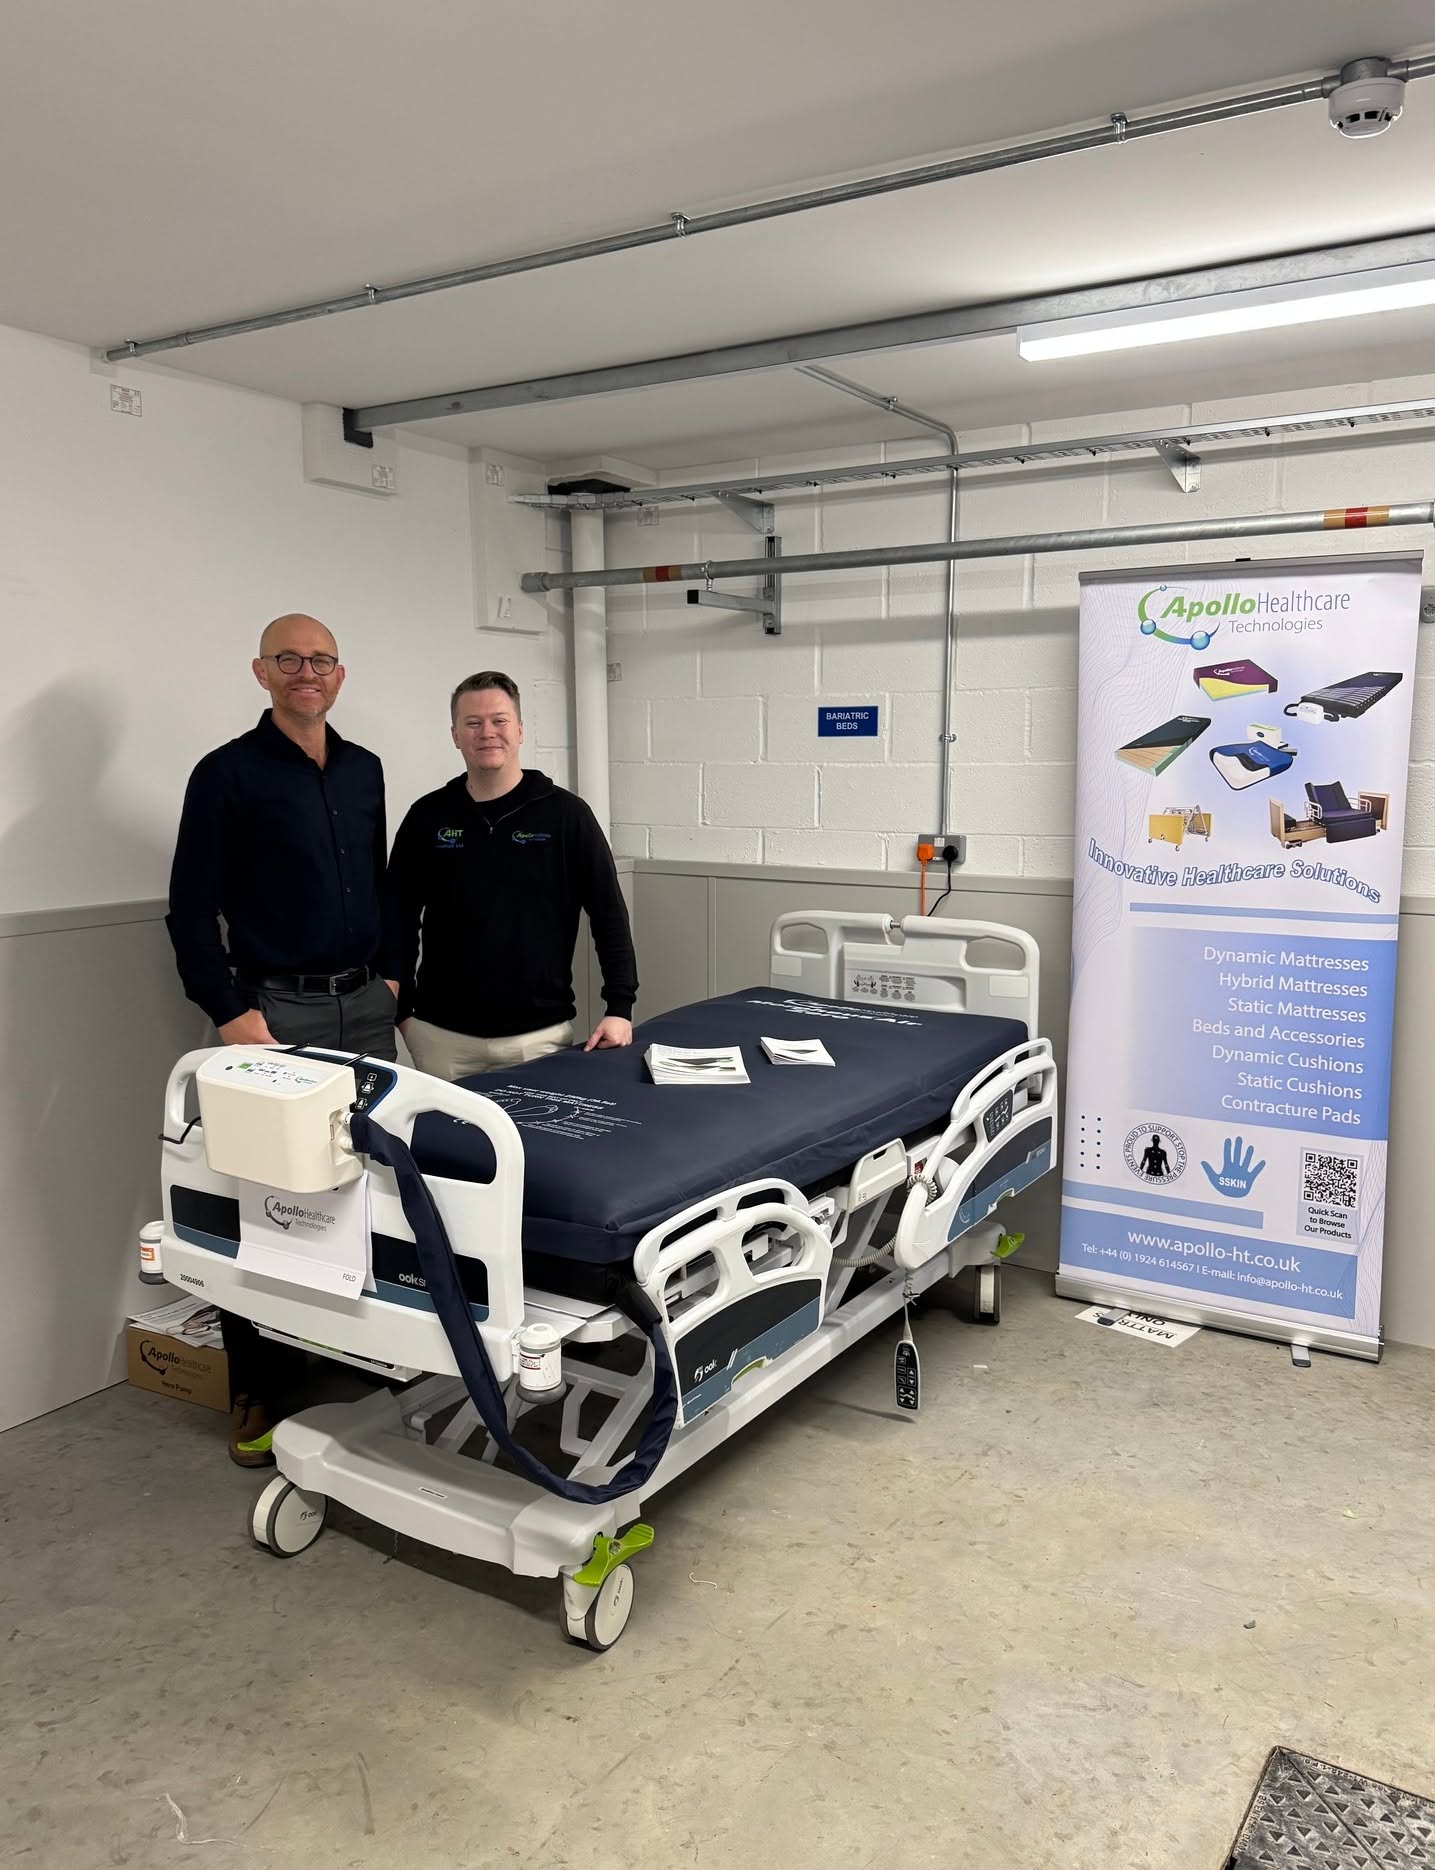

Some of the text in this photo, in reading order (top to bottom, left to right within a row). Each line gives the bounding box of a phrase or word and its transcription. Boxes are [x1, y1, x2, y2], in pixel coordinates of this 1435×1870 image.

[1228, 617, 1323, 633] Technologies
[826, 712, 869, 720] BARIATRIC
[836, 722, 858, 730] BEDS
[443, 829, 464, 838] AHT
[1088, 837, 1381, 903] Innovative Healthcare Solutions
[1203, 946, 1369, 971] Dynamic Mattresses
[1219, 972, 1368, 997] Hybrid Mattresses
[1227, 997, 1367, 1023] Static Mattresses
[1192, 1019, 1365, 1049] Beds and Accessories
[1212, 1044, 1364, 1074] Dynamic Cushions
[1237, 1072, 1363, 1100] Static Cushions
[1221, 1094, 1361, 1125] Contracture Pads
[1125, 1124, 1186, 1183] PROUD TO SUPPORT STOP THE PRESSURE EVENTS
[1218, 1176, 1247, 1189] SSKIN
[295, 1218, 327, 1232] Technologies
[1308, 1206, 1348, 1219] Quick Scan
[1319, 1217, 1346, 1228] Browse
[1319, 1227, 1352, 1239] Products
[1127, 1231, 1301, 1273] www.apollo-ht.co.uk
[342, 1272, 356, 1283] FOLD
[1081, 1243, 1098, 1254] Tel:
[1100, 1248, 1118, 1258] +44
[1119, 1250, 1132, 1262] (0)
[1134, 1253, 1157, 1265] 1924
[1159, 1258, 1194, 1272] 614567
[1201, 1265, 1236, 1280] E-mail:
[1237, 1271, 1344, 1300] info@apollo-ht.co.uk
[1092, 1312, 1175, 1339] MATTRS
